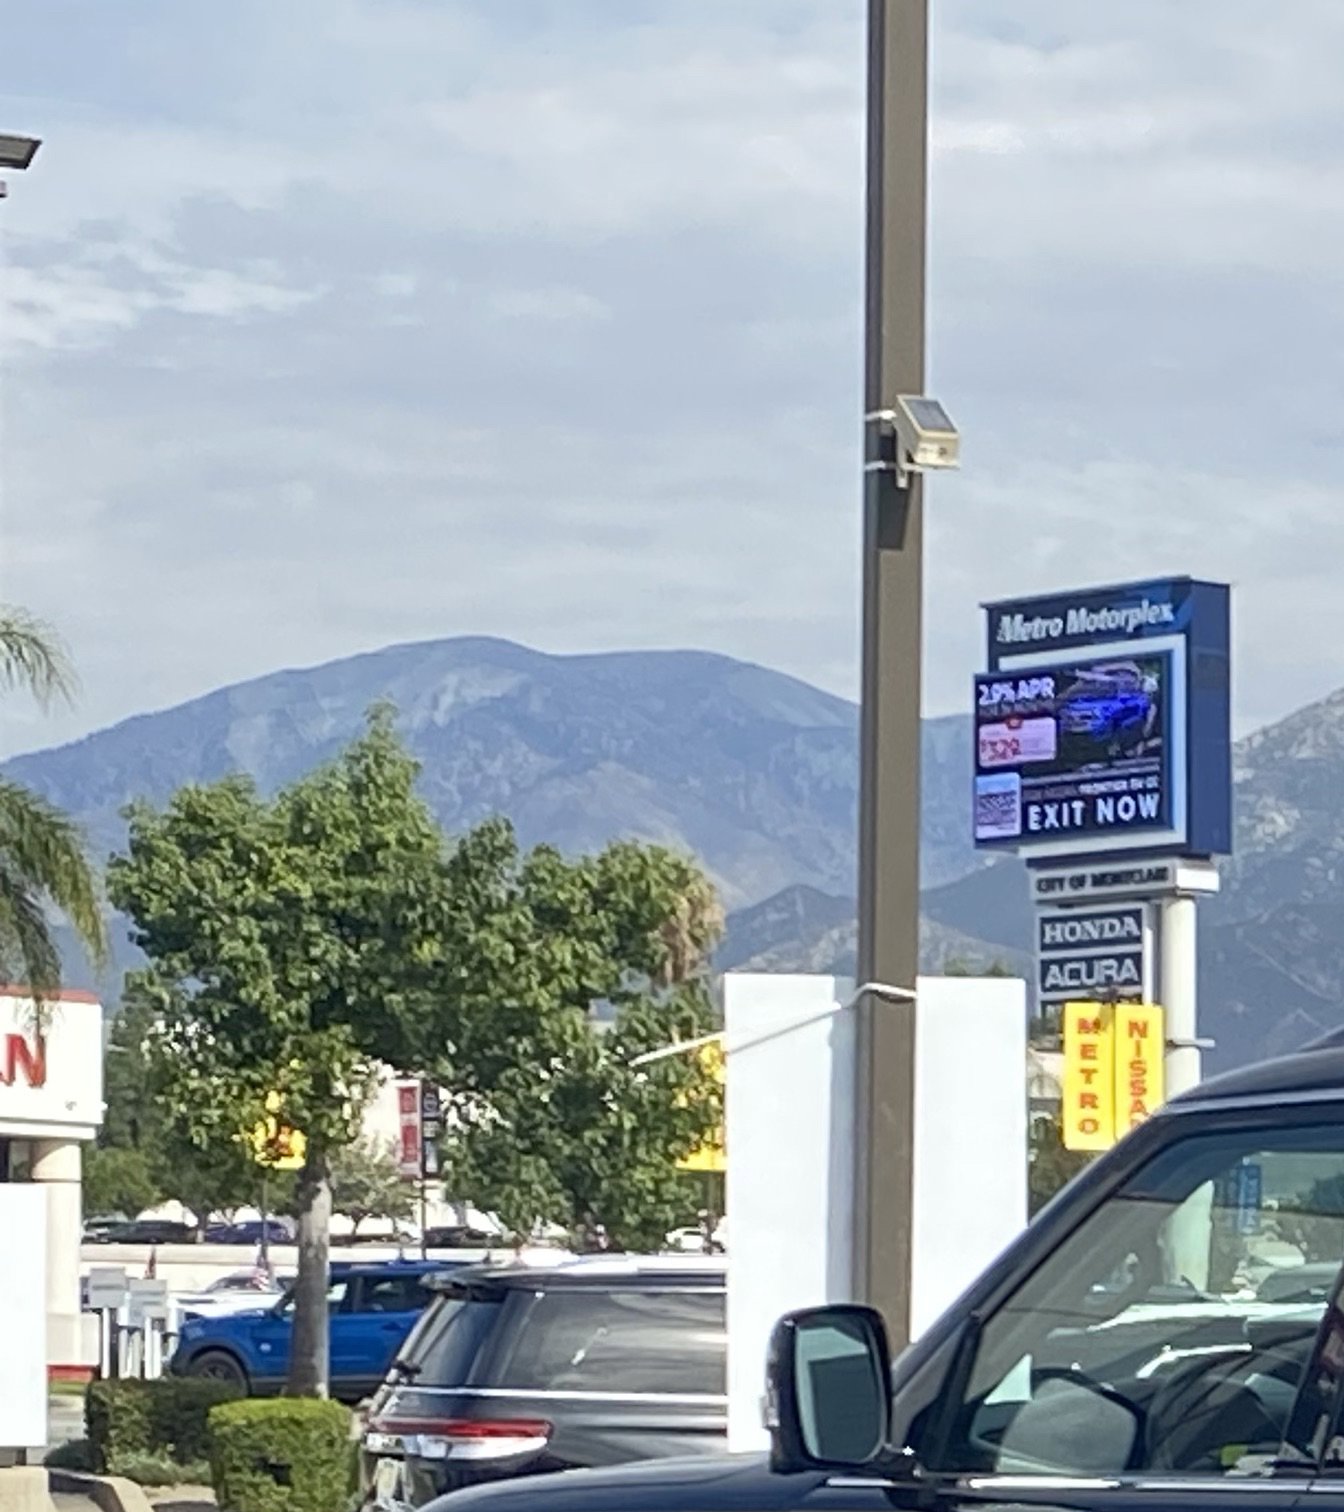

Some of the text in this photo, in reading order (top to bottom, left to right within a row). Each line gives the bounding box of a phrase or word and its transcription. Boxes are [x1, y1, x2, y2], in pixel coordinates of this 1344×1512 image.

[996, 598, 1175, 642] Metro Motorplex
[1017, 676, 1055, 700] APR
[1027, 792, 1161, 830] EXIT NOW
[1042, 915, 1141, 944] HONDA
[1045, 958, 1139, 988] ACURA
[1077, 1018, 1099, 1134] METRO
